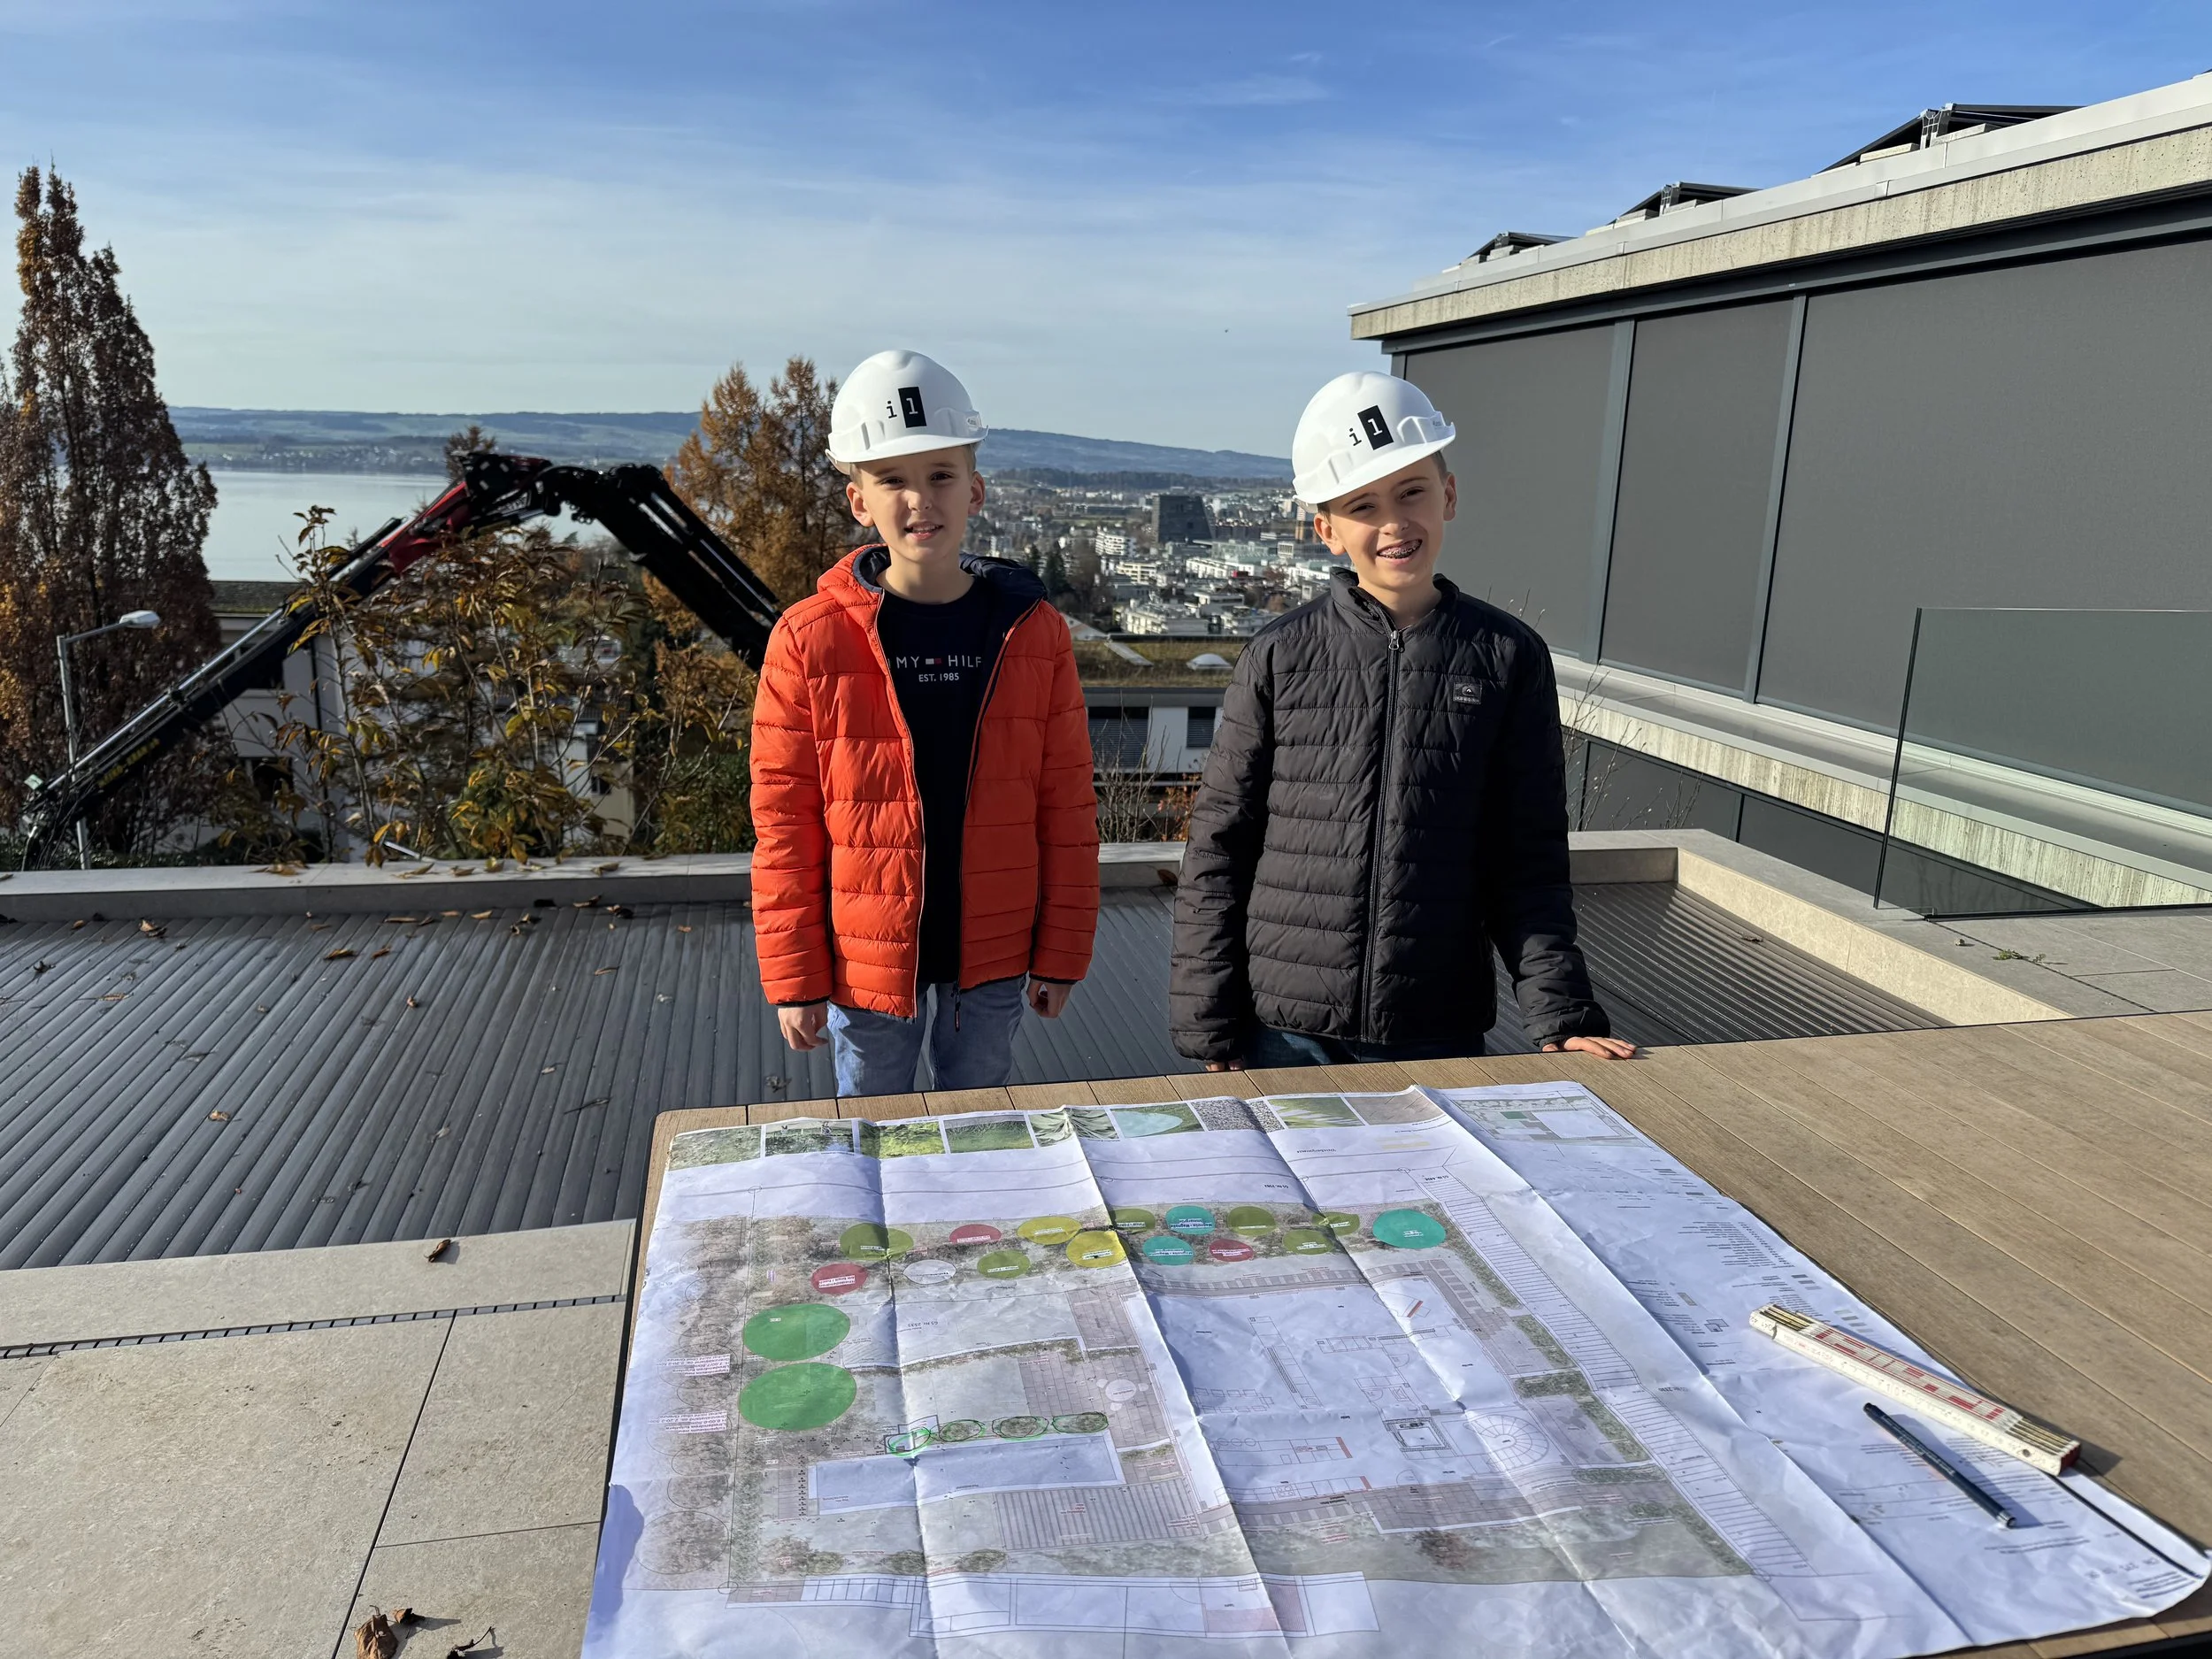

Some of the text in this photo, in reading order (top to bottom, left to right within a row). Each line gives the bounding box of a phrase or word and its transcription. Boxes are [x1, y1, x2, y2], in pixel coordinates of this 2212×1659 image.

[887, 655, 982, 669] MY HILF
[918, 672, 960, 682] EST. 1985
